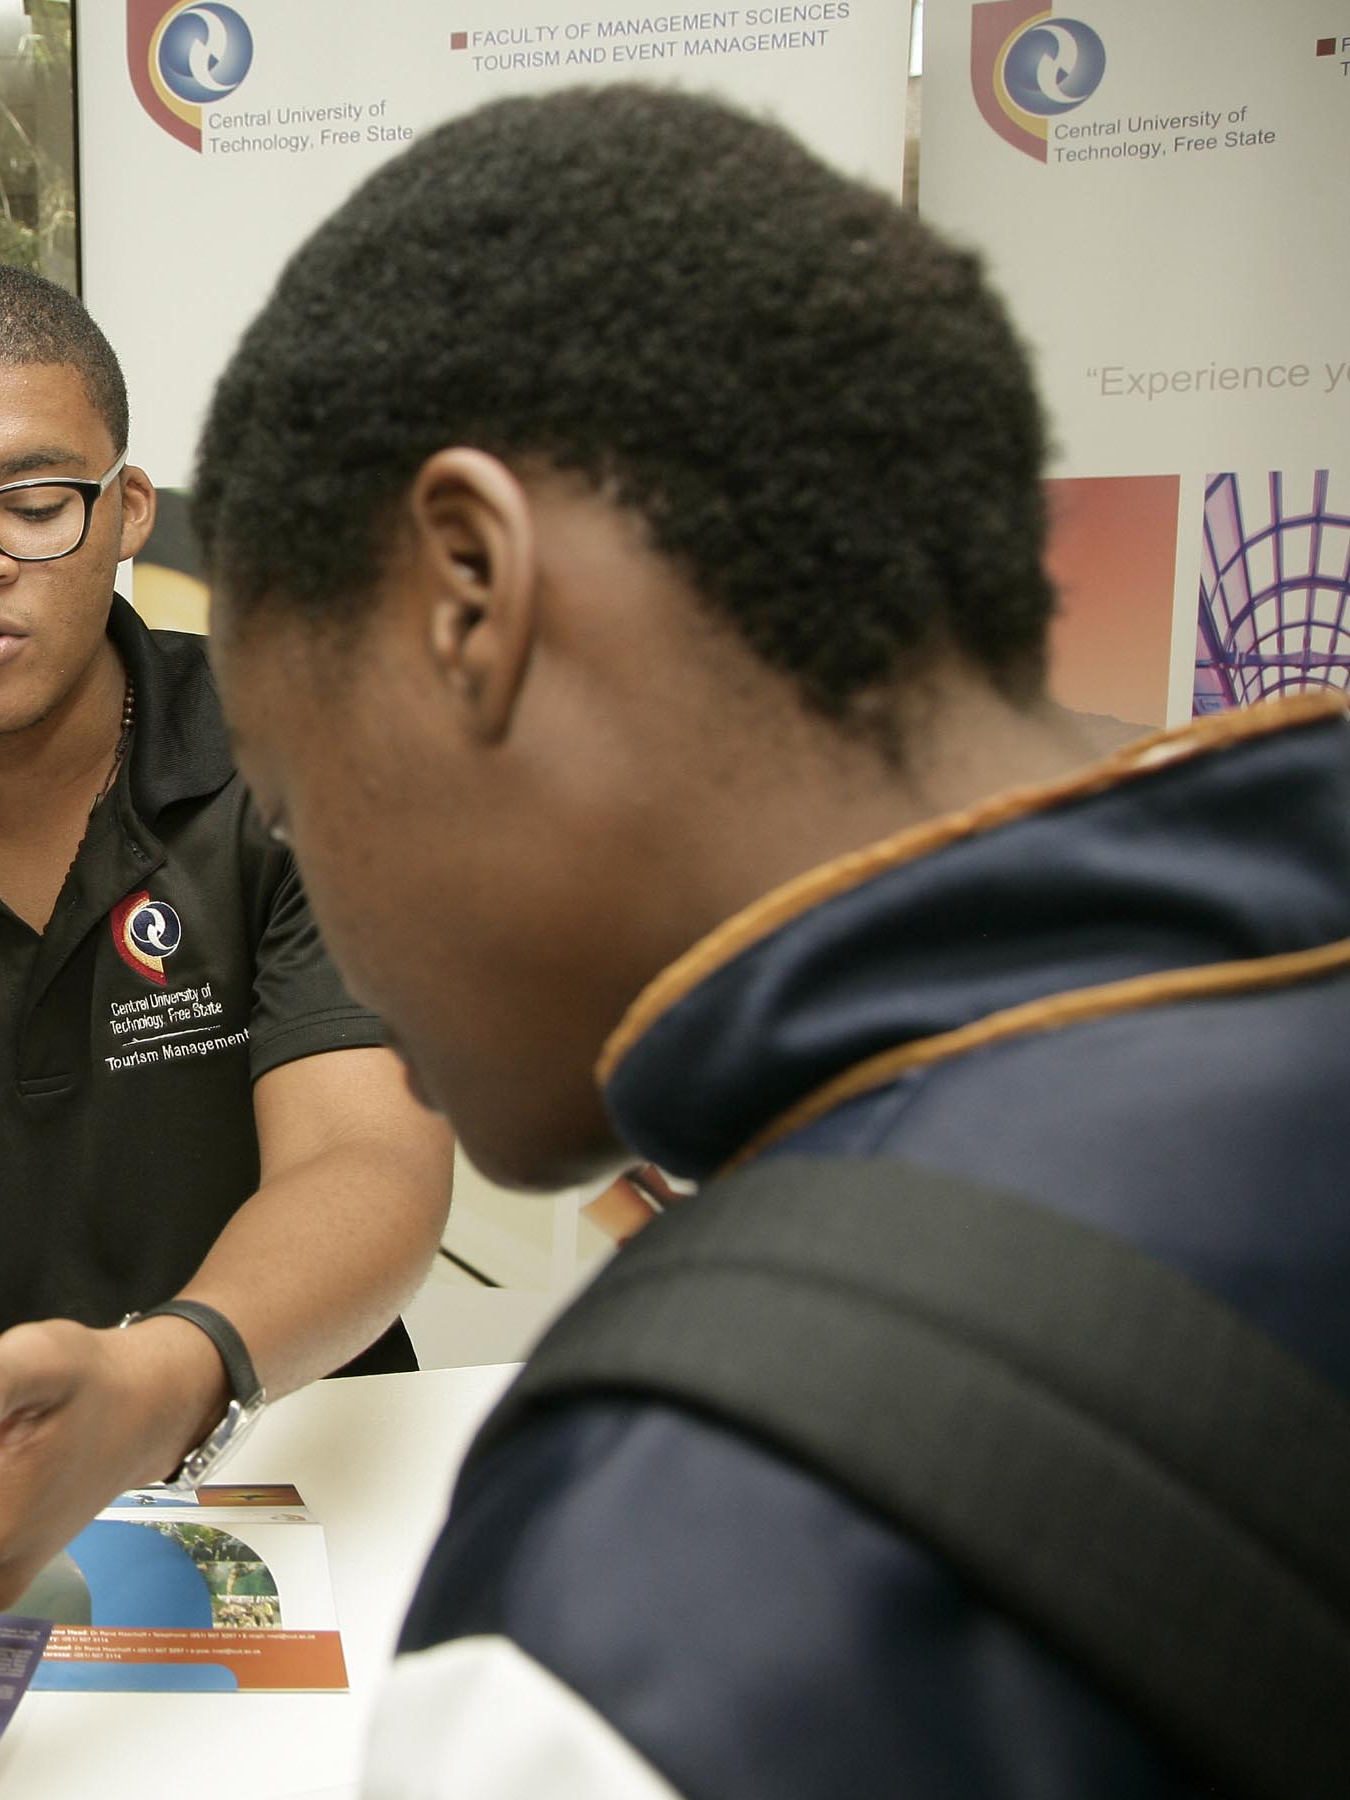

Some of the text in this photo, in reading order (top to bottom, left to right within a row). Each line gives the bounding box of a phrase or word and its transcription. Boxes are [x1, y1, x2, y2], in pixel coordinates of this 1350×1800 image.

[471, 2, 850, 47] FACULTY OF MANAGEMENT SCIENCES
[473, 29, 829, 71] TOURISM AND EVENT MANAGEMENT
[208, 99, 386, 130] Central University of
[1054, 106, 1248, 140] Central University of
[209, 125, 414, 154] Technology, Free State
[1053, 128, 1276, 163] Technology, Free State
[110, 982, 212, 1016] Central University of
[167, 1007, 191, 1023] Free
[192, 1000, 223, 1018] State
[104, 1028, 250, 1071] Tourism Management
